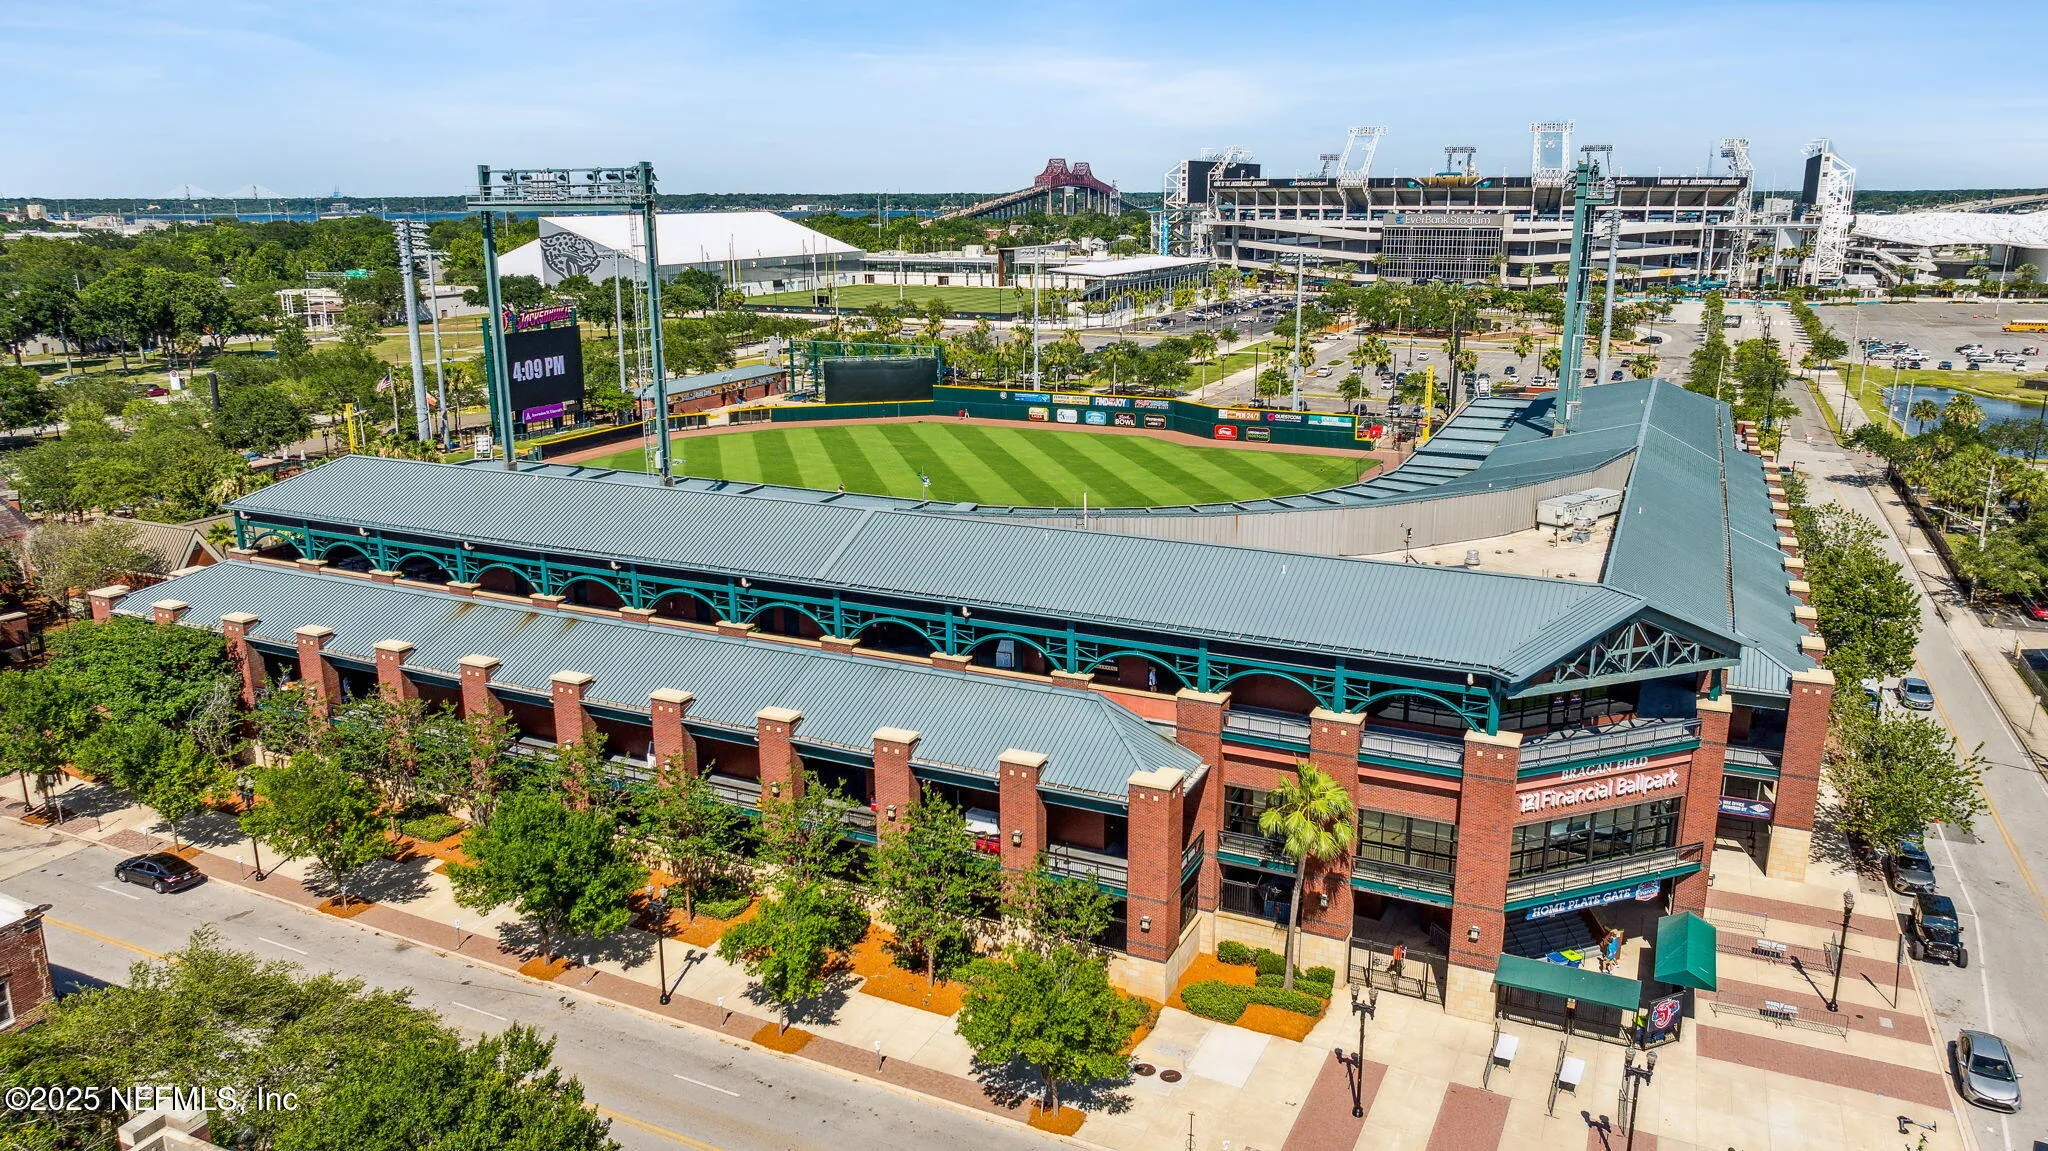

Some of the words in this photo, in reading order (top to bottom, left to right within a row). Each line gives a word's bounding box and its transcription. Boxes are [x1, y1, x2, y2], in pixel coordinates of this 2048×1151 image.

[1405, 214, 1449, 224] EverBank
[1450, 215, 1490, 225] Stadium
[513, 359, 543, 382] 4:09
[544, 355, 566, 377] PM
[1115, 418, 1135, 426] BOWL
[1561, 763, 1613, 781] BRAGAN
[1616, 756, 1649, 771] FIELD
[1540, 778, 1614, 809] Financial
[1616, 768, 1680, 797] Ballpark
[1532, 902, 1566, 917] HOME
[1568, 895, 1601, 910] PLATE
[1603, 888, 1631, 903] GATE
